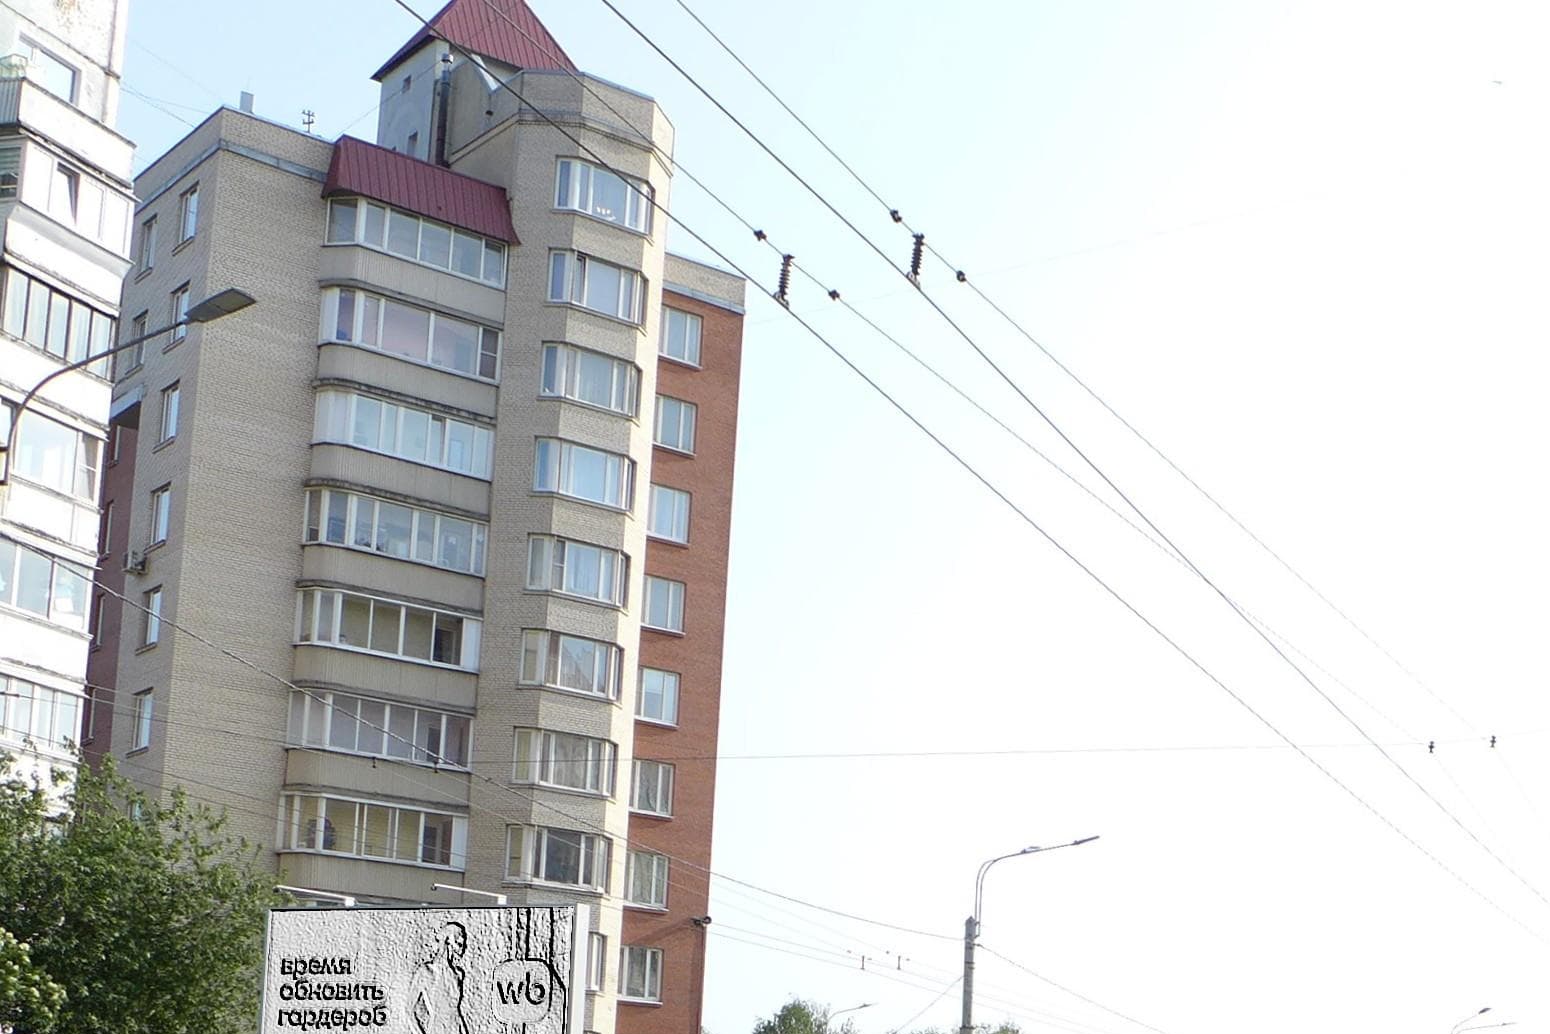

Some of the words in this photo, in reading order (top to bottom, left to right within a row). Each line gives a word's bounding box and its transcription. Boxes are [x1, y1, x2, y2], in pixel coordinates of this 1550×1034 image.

[281, 957, 352, 980] время
[280, 980, 385, 1000] обновить
[496, 971, 546, 1005] wb
